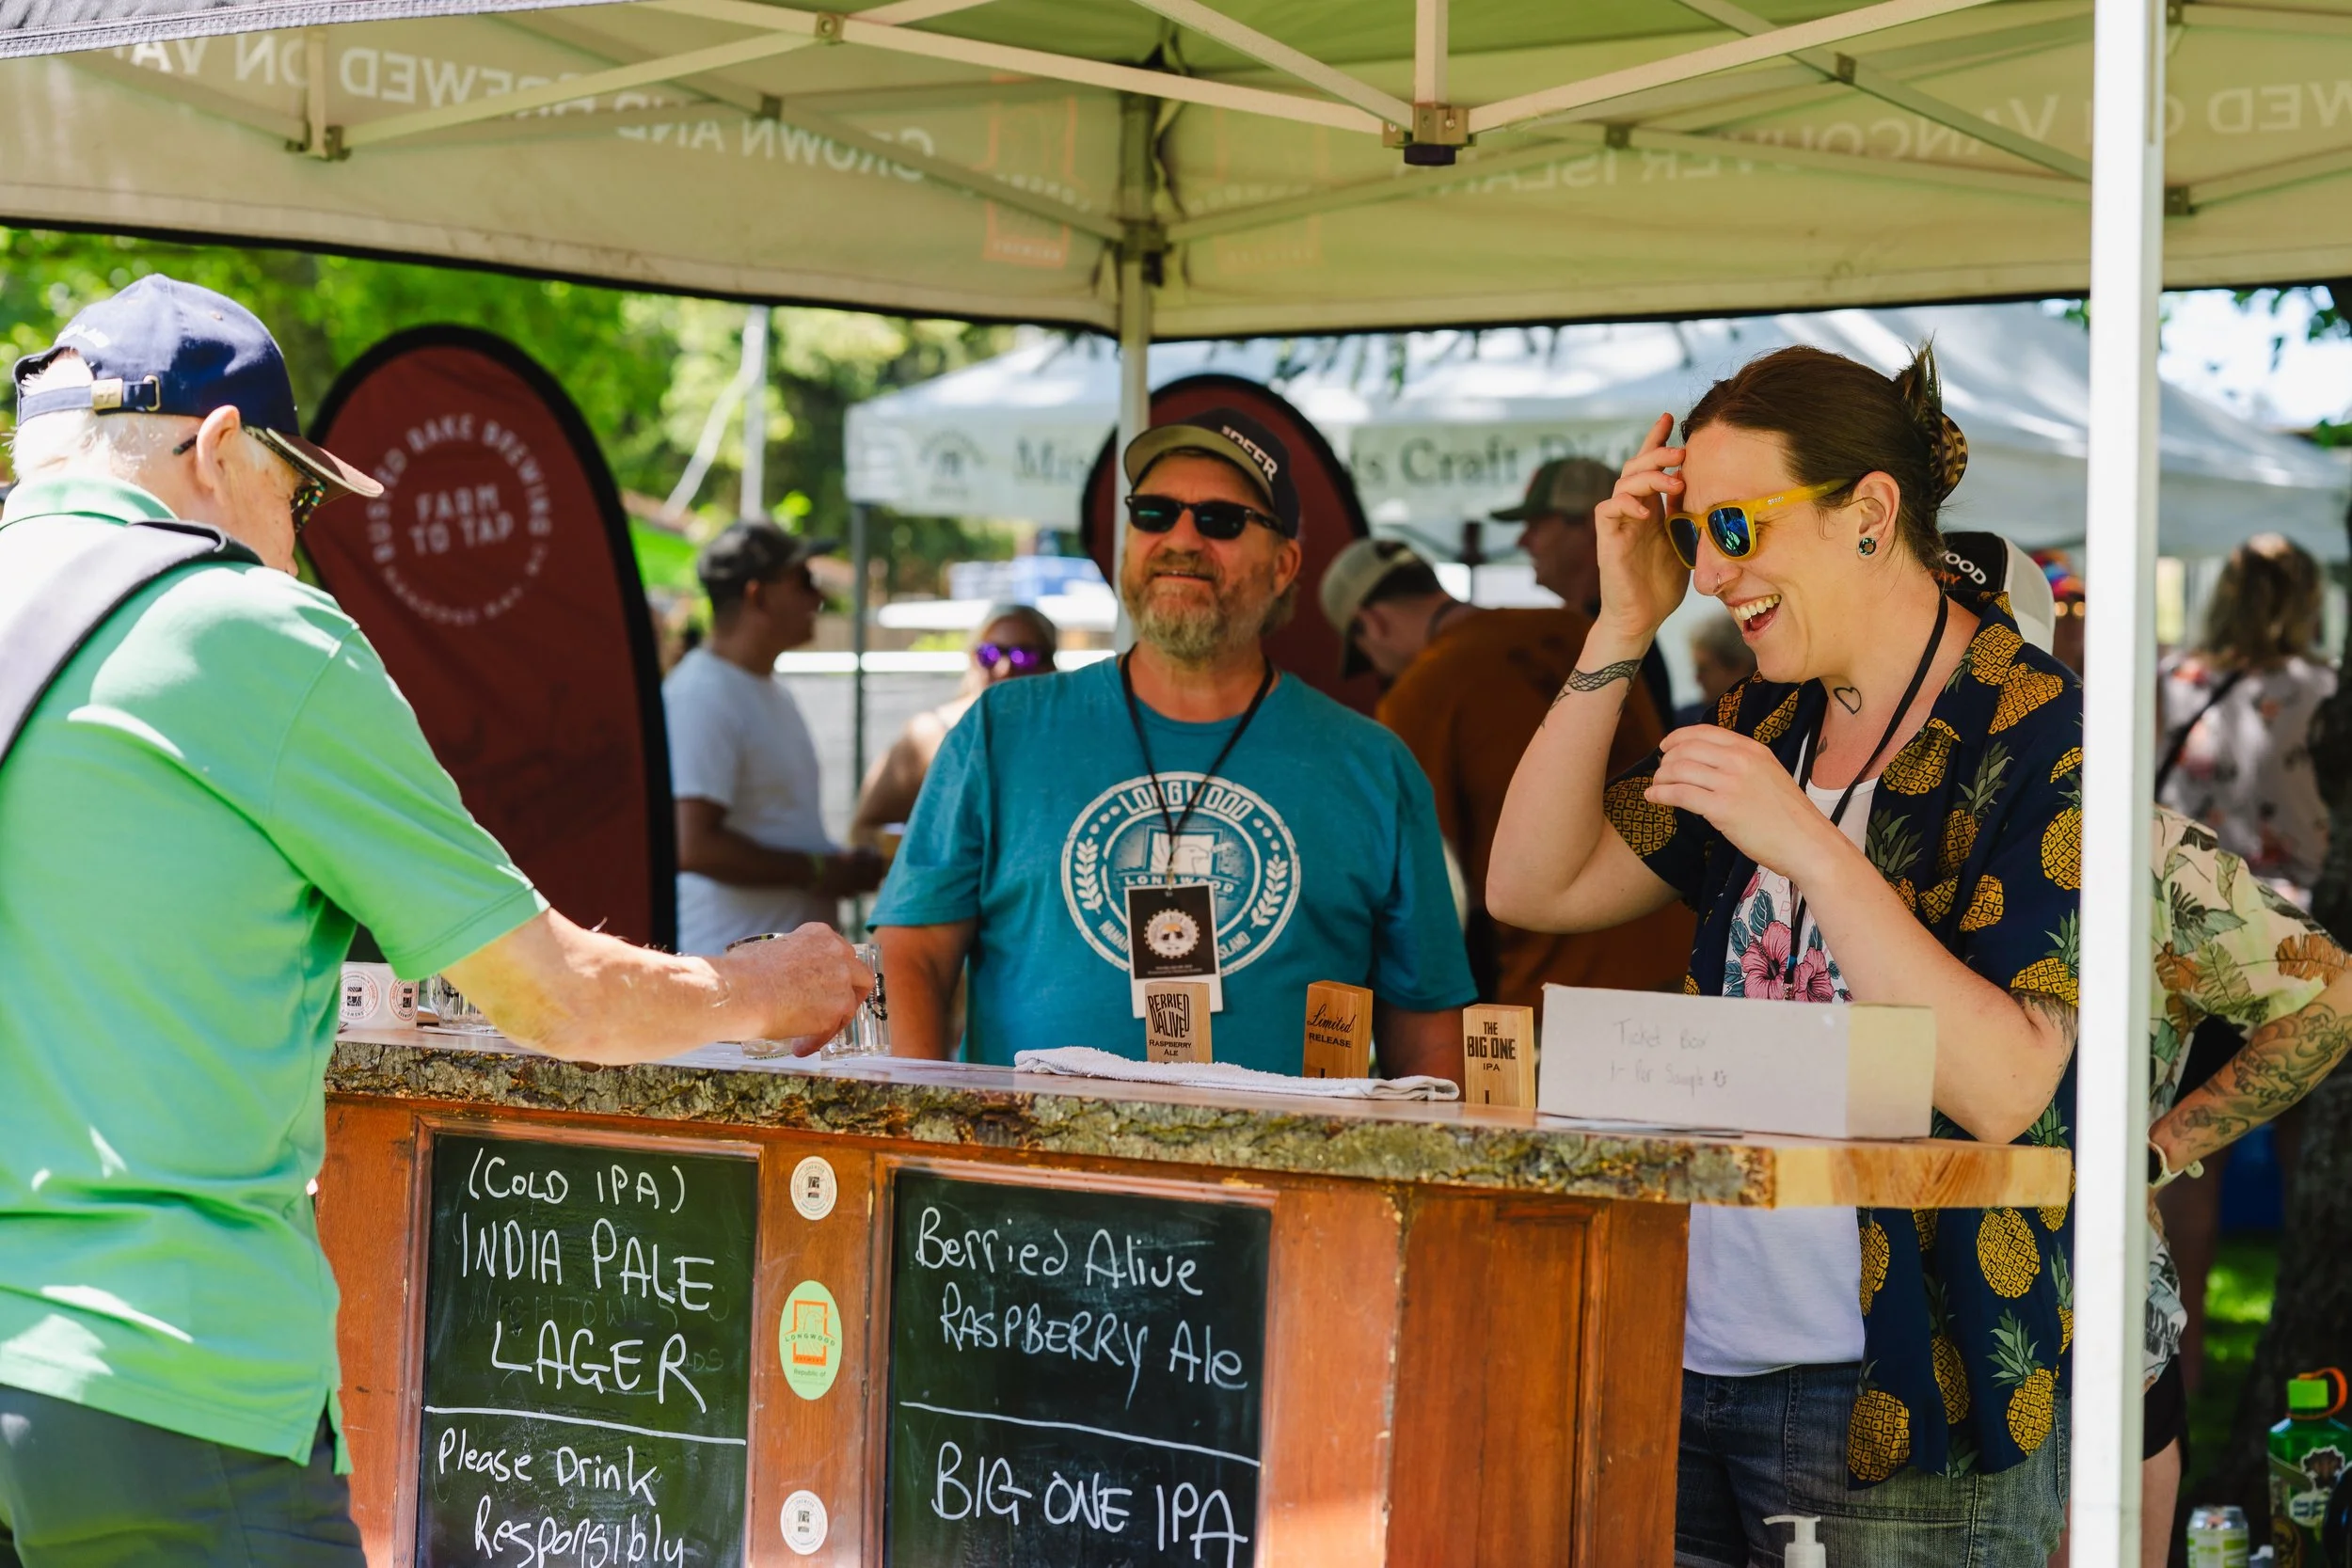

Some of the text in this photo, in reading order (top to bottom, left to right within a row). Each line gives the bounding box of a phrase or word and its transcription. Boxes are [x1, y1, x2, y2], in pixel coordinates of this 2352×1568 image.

[1938, 549, 1987, 585] OOD
[1147, 993, 1190, 1033] BERRIED
[1156, 1010, 1186, 1038] ALIVE
[1307, 1003, 1357, 1033] Limited
[1484, 1022, 1499, 1035] THE
[1149, 1039, 1192, 1049] RASPBERRY
[1309, 1032, 1352, 1048] RELEASE
[1467, 1036, 1516, 1060] BIG ONE
[1483, 1063, 1501, 1071] IPA
[597, 1164, 686, 1213] IPA)
[462, 1212, 715, 1311] INDIA PALE
[915, 1207, 1204, 1296] Berried Alive
[785, 1333, 835, 1346] LONGWOOD
[940, 1282, 1248, 1410] RASPBERRY Ale
[491, 1320, 707, 1414] LAGER
[438, 1427, 658, 1507] Please Drink
[931, 1441, 1248, 1568] BIG ONE IPA
